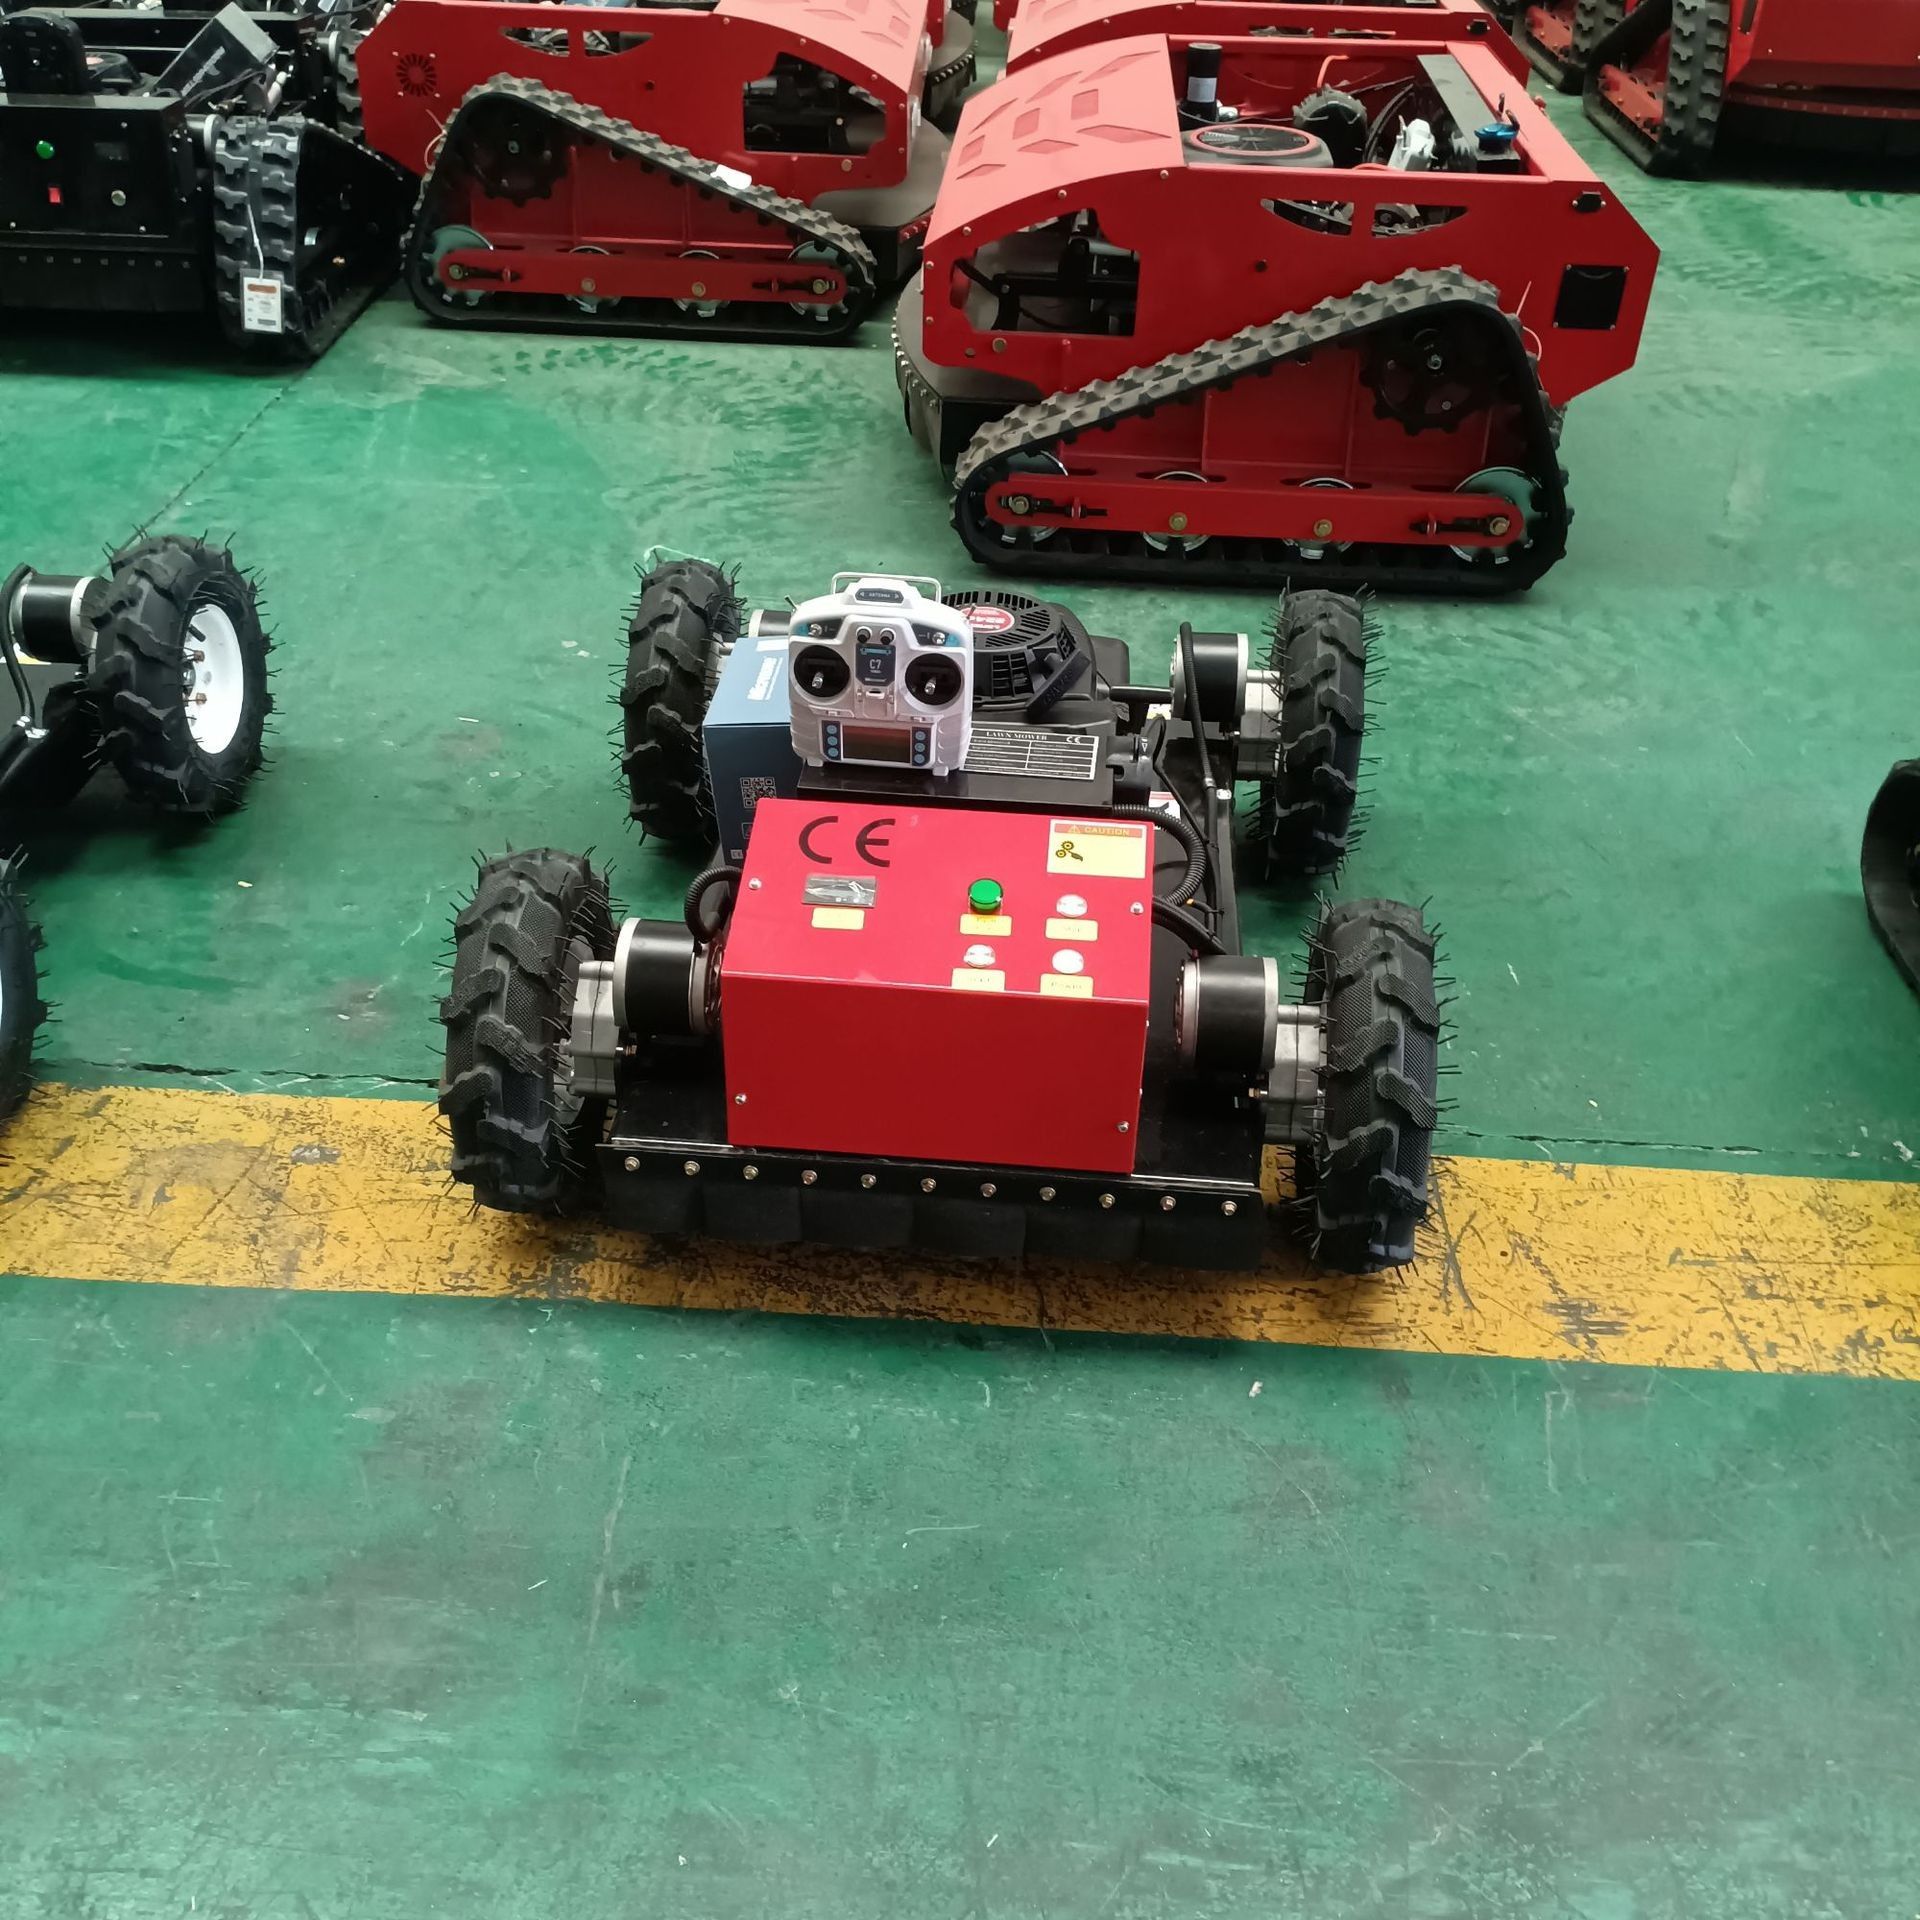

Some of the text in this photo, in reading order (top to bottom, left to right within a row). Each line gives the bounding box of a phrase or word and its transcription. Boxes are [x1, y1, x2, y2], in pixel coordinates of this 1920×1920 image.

[869, 659, 882, 670] C7
[986, 731, 1048, 741] LAWN MOWER
[1084, 827, 1130, 837] CAUTION
[799, 815, 896, 868] CE
